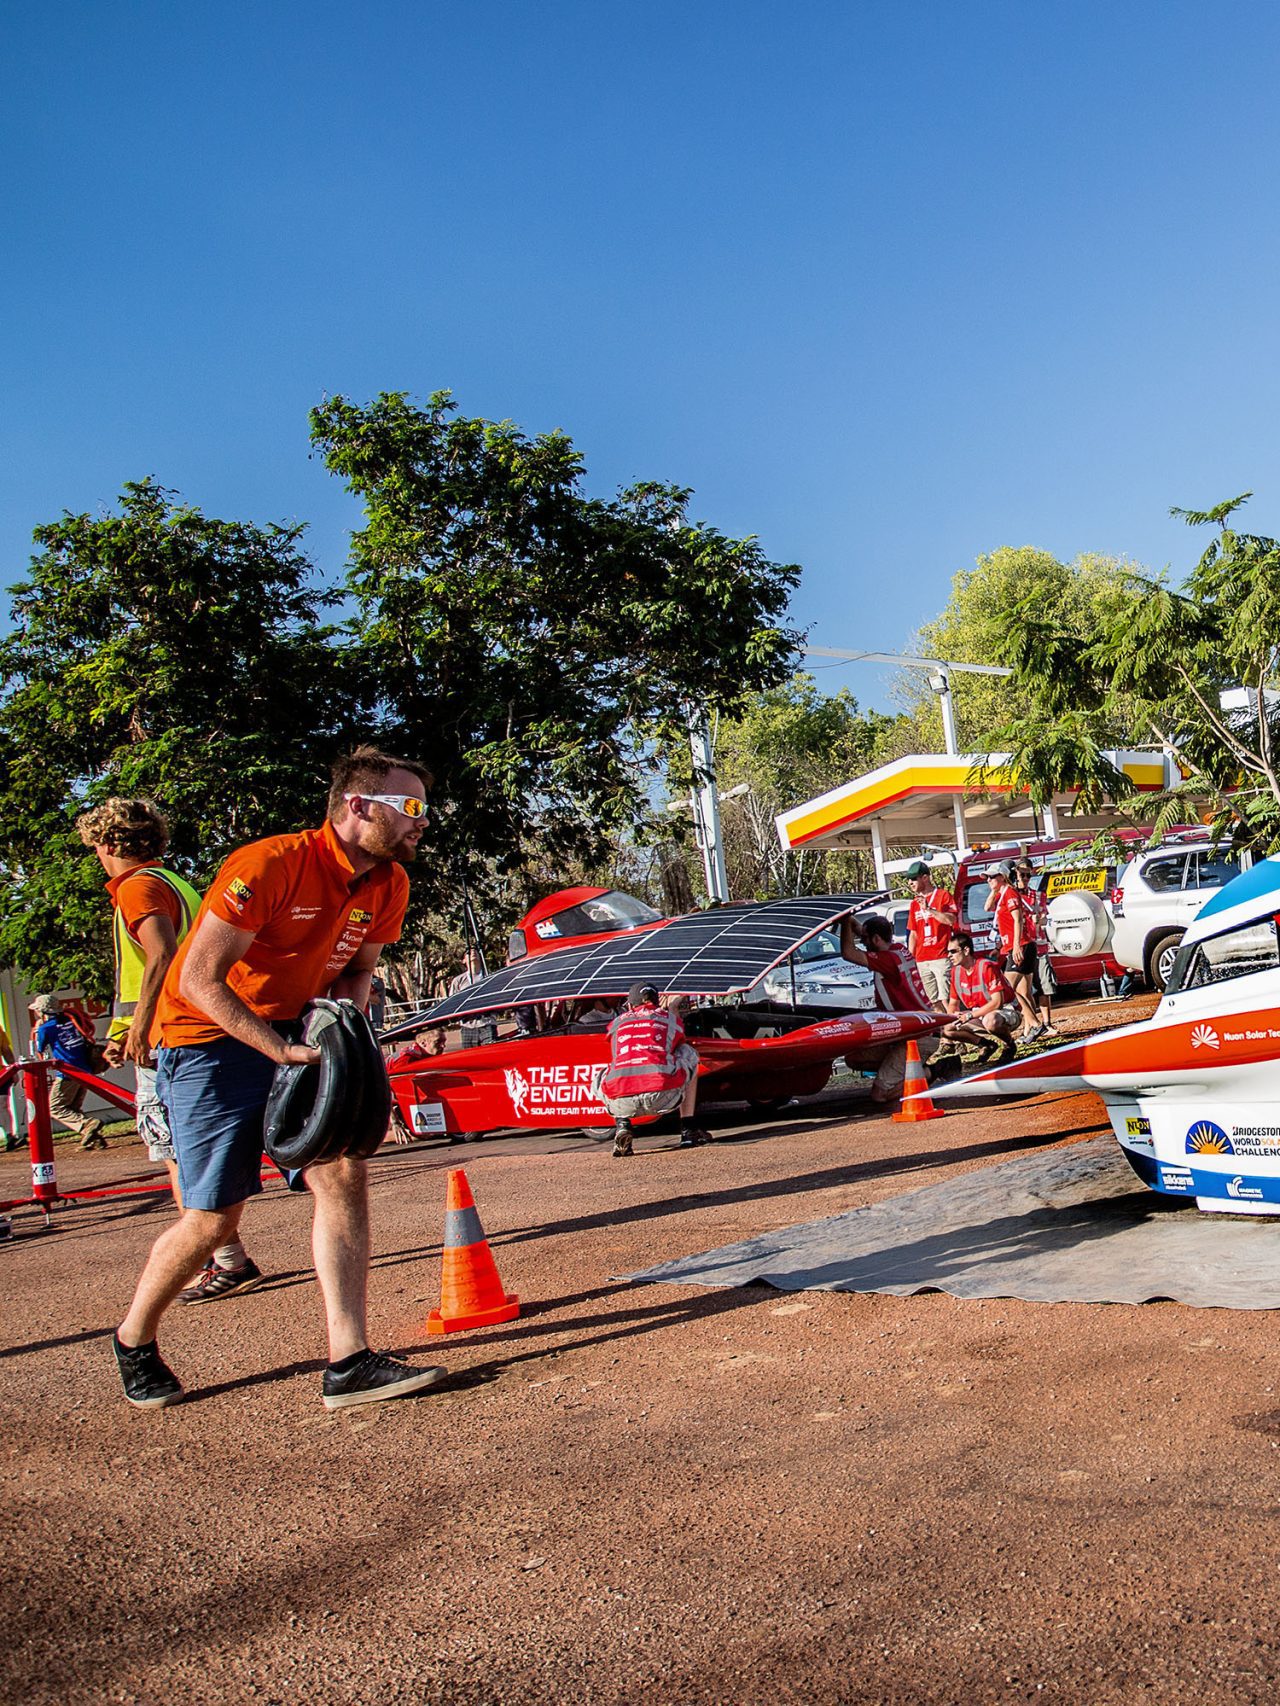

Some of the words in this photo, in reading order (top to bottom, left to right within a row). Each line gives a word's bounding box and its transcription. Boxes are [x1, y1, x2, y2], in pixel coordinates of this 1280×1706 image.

[795, 961, 838, 977] Panasonic
[1223, 1032, 1245, 1041] Nuon
[1245, 1030, 1267, 1039] Solar
[527, 1066, 569, 1083] THE
[573, 1063, 609, 1082] RE
[530, 1085, 599, 1102] ENGIN
[530, 1107, 556, 1115] SOLAR
[557, 1107, 580, 1115] TEAM
[581, 1106, 609, 1115] TWEN
[1127, 1119, 1150, 1132] NUON
